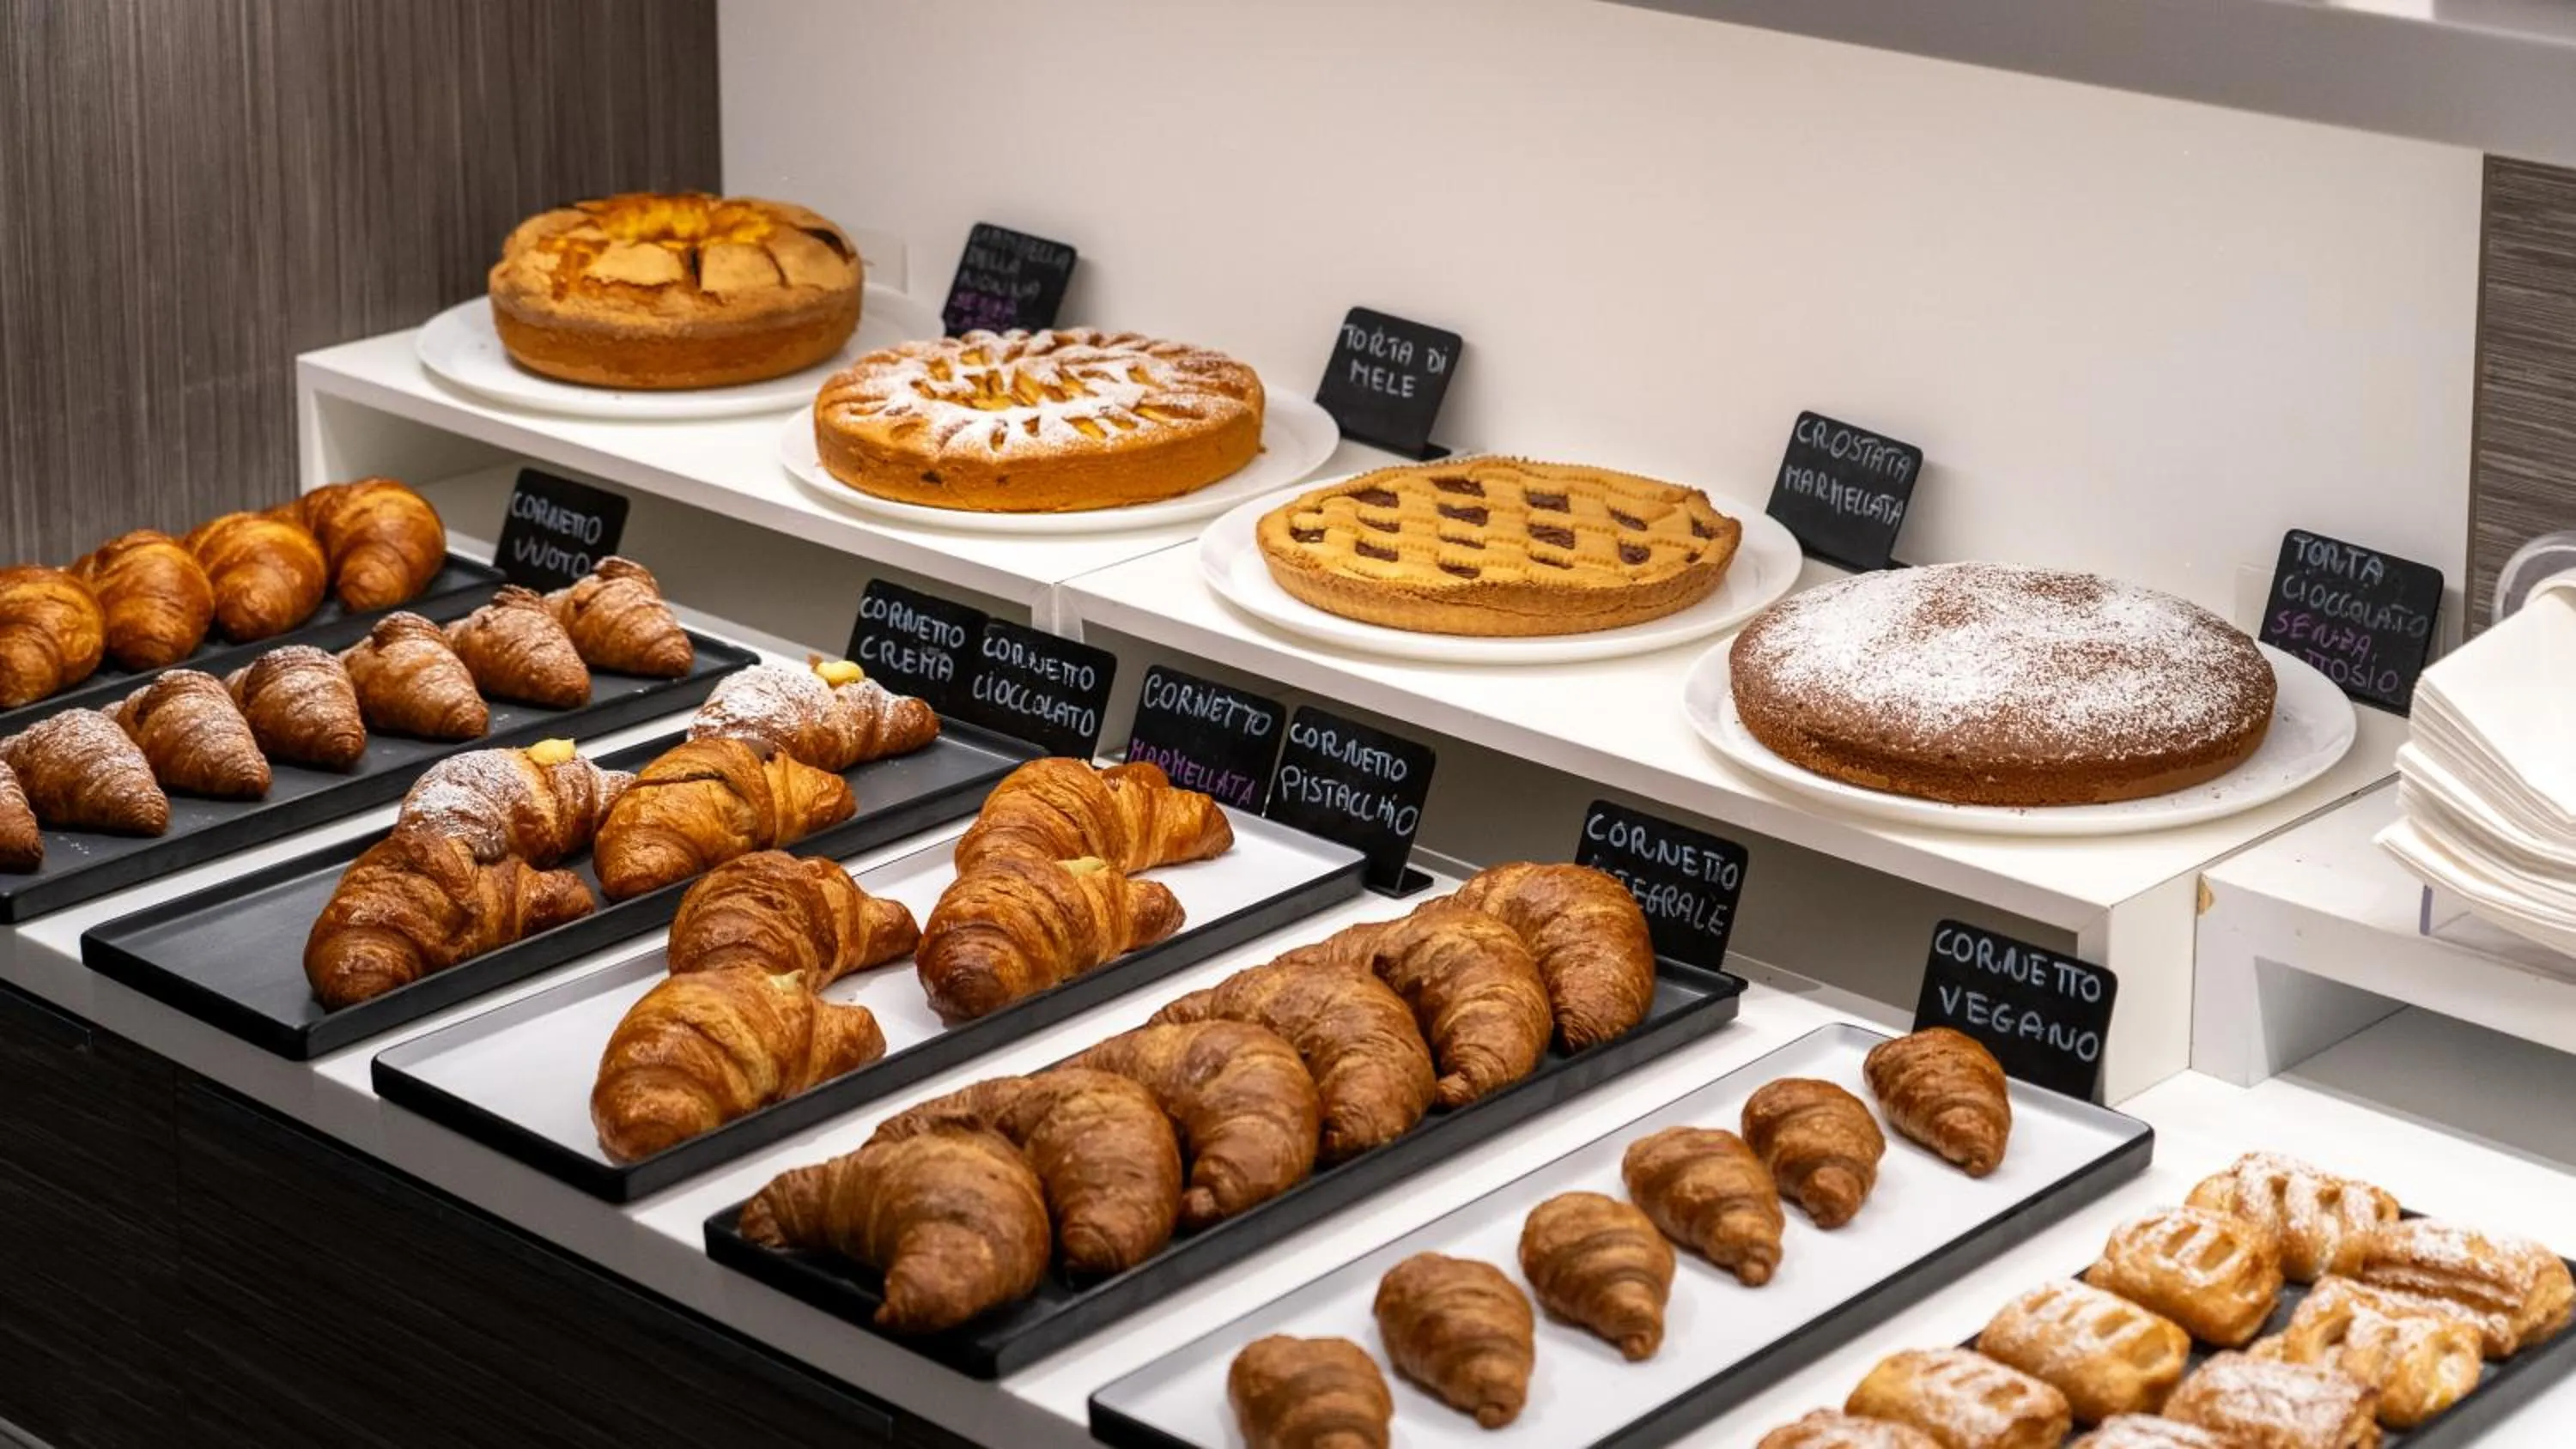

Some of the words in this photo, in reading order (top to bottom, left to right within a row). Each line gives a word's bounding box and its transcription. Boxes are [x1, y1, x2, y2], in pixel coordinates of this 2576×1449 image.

[1342, 323, 1413, 366] TORTA
[1349, 359, 1416, 398] MELE
[1795, 419, 1912, 483] CROSTATA
[511, 490, 603, 546] CORNETTO
[1784, 464, 1905, 526] MARMELLATA
[514, 536, 592, 579] VUOTO
[2293, 534, 2385, 585] TORTA
[859, 597, 966, 649] CORNETTO
[2281, 568, 2428, 639] CIOCCOLATO
[860, 635, 954, 684] CREMA
[982, 636, 1095, 691] CORNETTO
[2270, 609, 2372, 660] SENZA
[2275, 640, 2399, 693] TTOSIO
[972, 670, 1095, 737] CIOCCOLATO
[1143, 673, 1273, 737] CORNETTO
[1290, 722, 1407, 783] CORNETTO
[1280, 764, 1419, 837] PISTACCHIO
[1587, 813, 1739, 890] CORNETTO
[1935, 928, 2101, 1003] CORNETTO
[1938, 985, 2099, 1063] VEGANO
